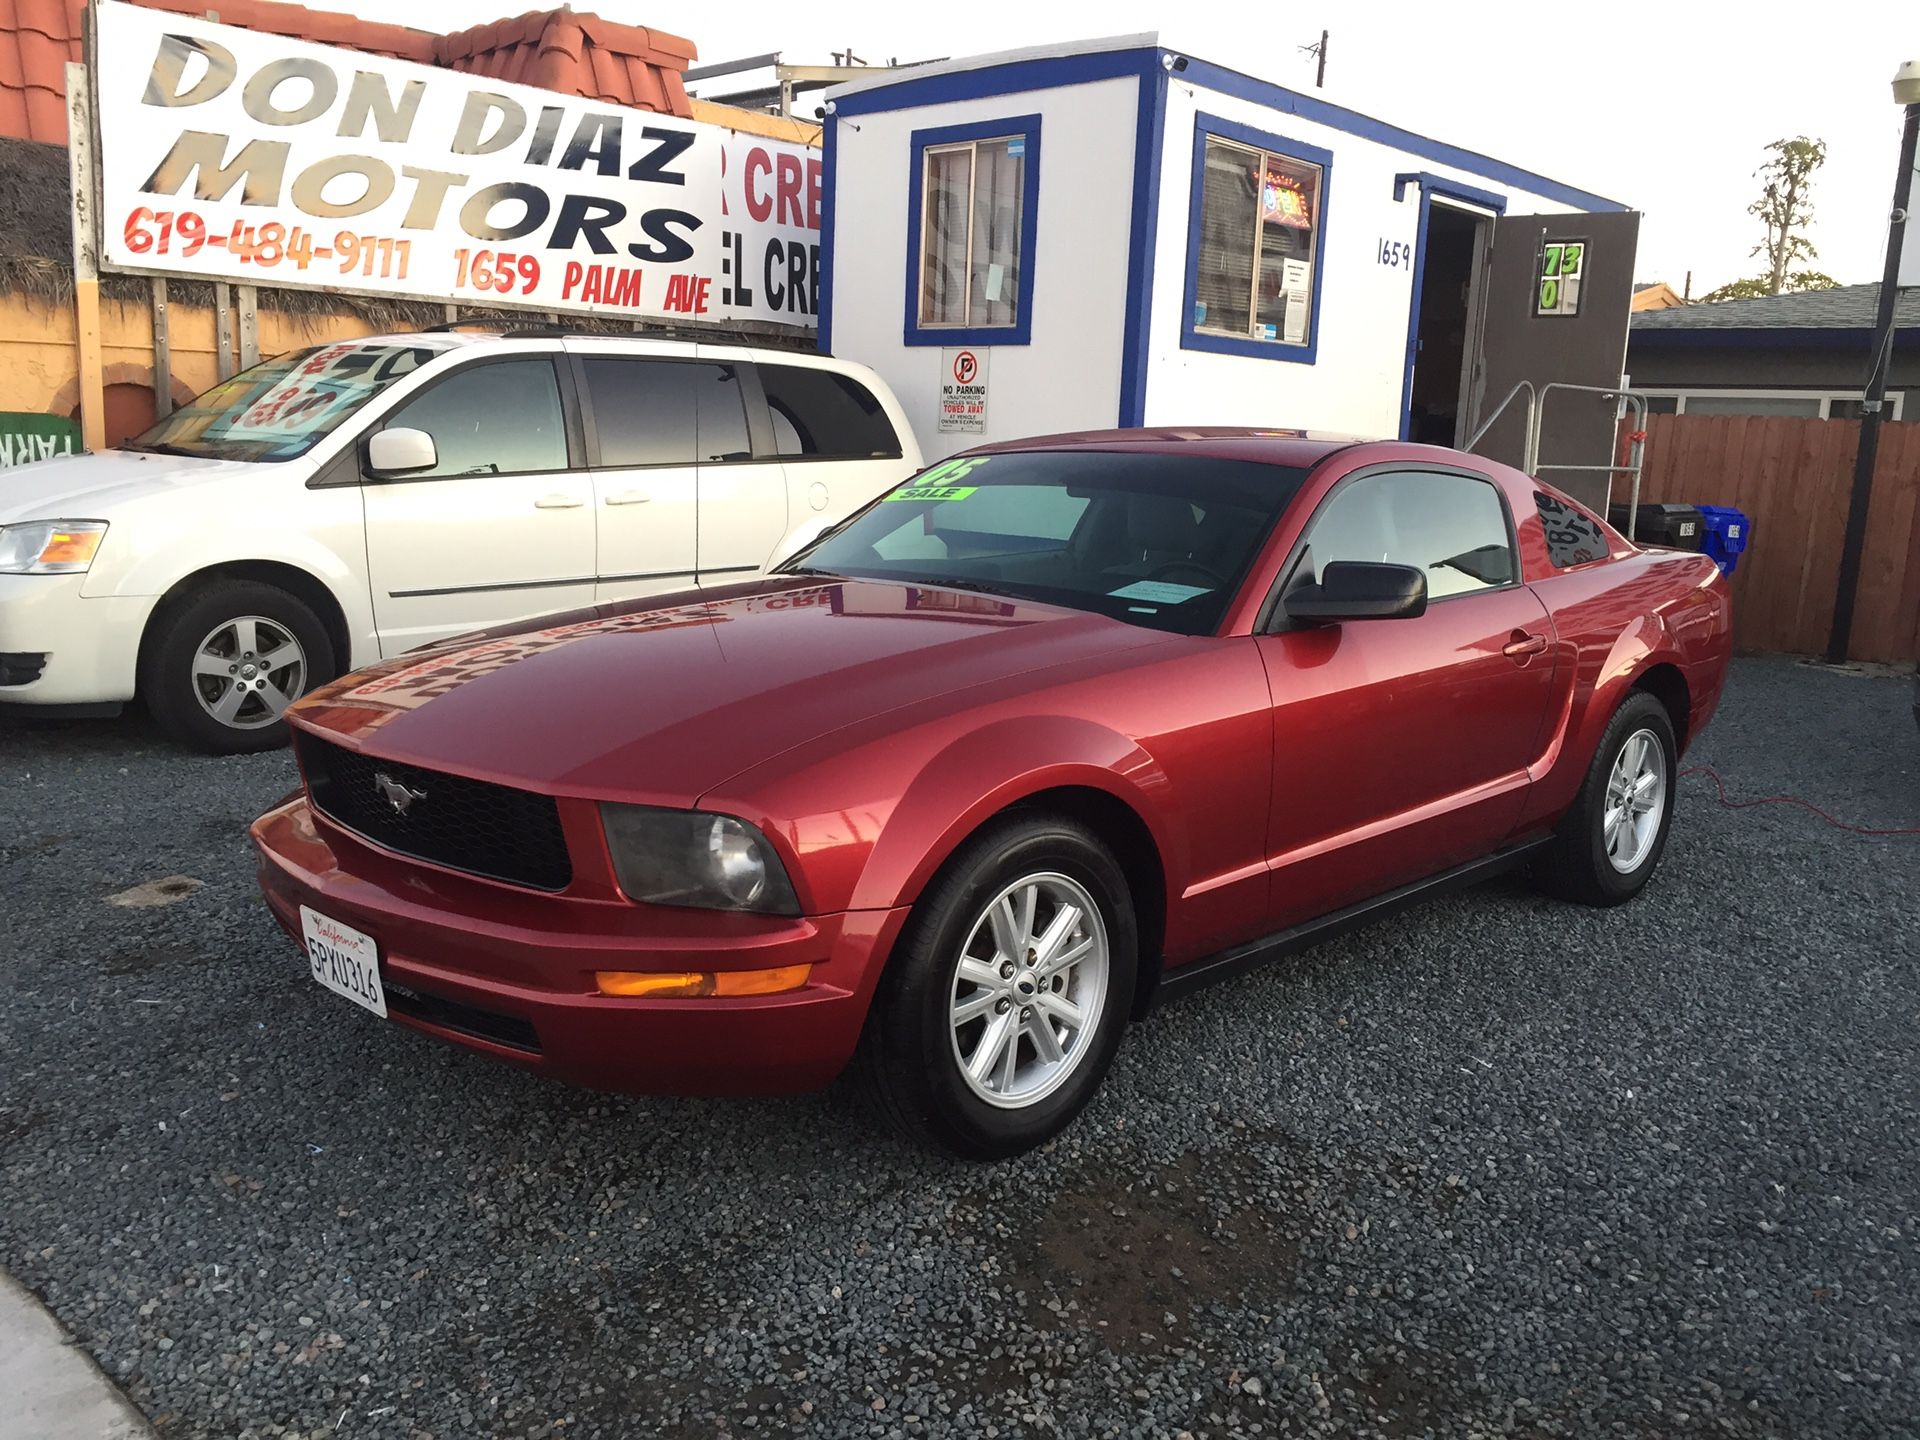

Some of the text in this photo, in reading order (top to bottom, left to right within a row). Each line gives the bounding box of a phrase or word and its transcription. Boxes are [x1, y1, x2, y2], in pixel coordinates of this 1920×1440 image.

[141, 33, 427, 143] DON
[450, 90, 696, 186] DIAZ
[138, 129, 704, 263] MOTORS
[124, 206, 712, 314] 619-484-9111 1659 PALM AVE
[1377, 237, 1410, 271] 1659
[943, 385, 985, 395] NO PARKING
[944, 405, 984, 414] TOWED AWAY
[899, 488, 961, 499] SALE
[308, 936, 378, 1004] 5PXU316
